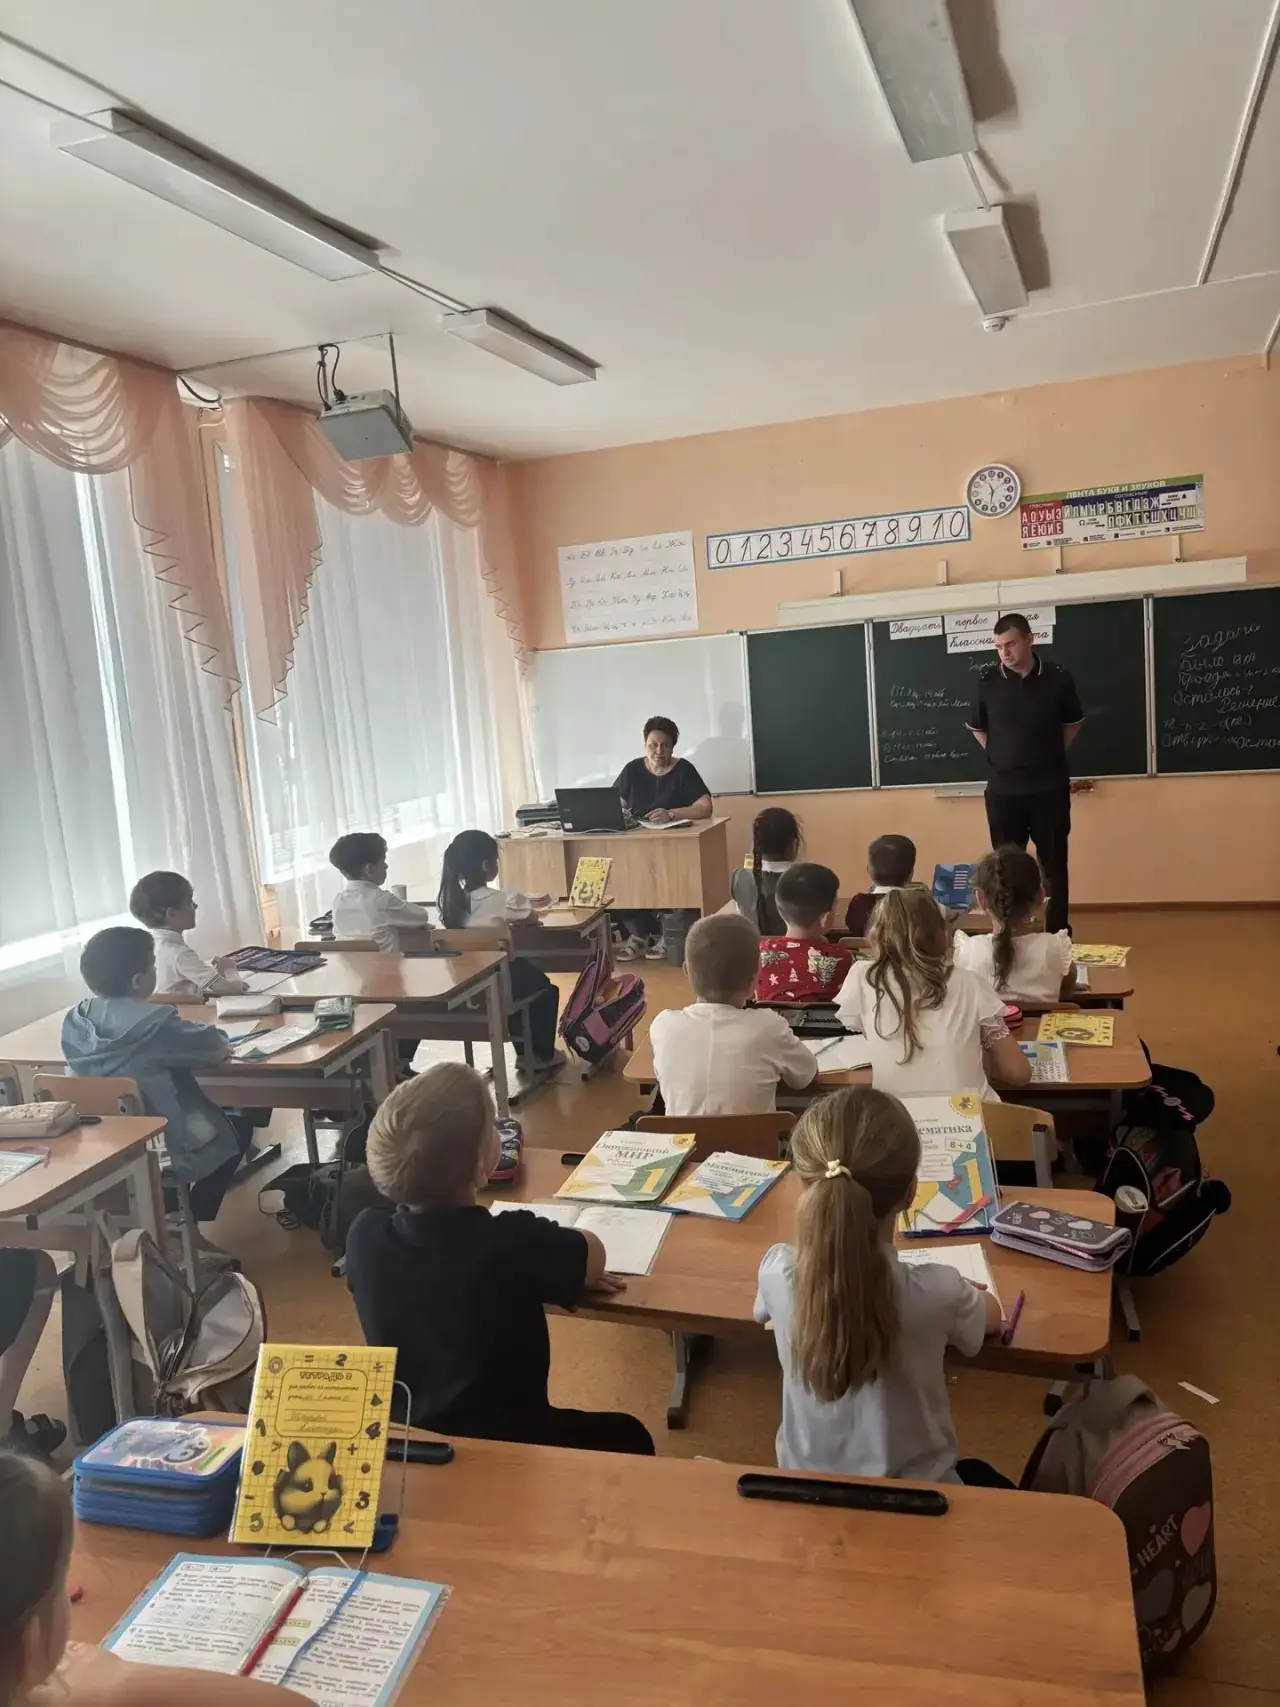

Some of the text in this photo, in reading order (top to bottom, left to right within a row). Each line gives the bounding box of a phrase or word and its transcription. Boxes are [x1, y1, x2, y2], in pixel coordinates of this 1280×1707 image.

[1066, 490, 1095, 499] ЛЕНТА
[1097, 488, 1119, 496] БУКВ
[1130, 480, 1166, 491] ЗВУКОВ
[716, 539, 730, 564] 0
[740, 536, 750, 562] 1
[757, 534, 772, 560] 2
[776, 532, 792, 557] 3
[801, 530, 812, 554] 4
[818, 526, 834, 552] 5
[840, 524, 855, 550] 6
[862, 522, 876, 547] 7
[884, 518, 899, 544] 8
[906, 516, 920, 542] 9
[890, 621, 942, 636] Двадцать
[950, 634, 995, 648] Классна
[919, 1124, 972, 1135] ематика
[633, 1168, 666, 1194] 1
[958, 1158, 984, 1204] 1
[1136, 1514, 1177, 1568] HEART
